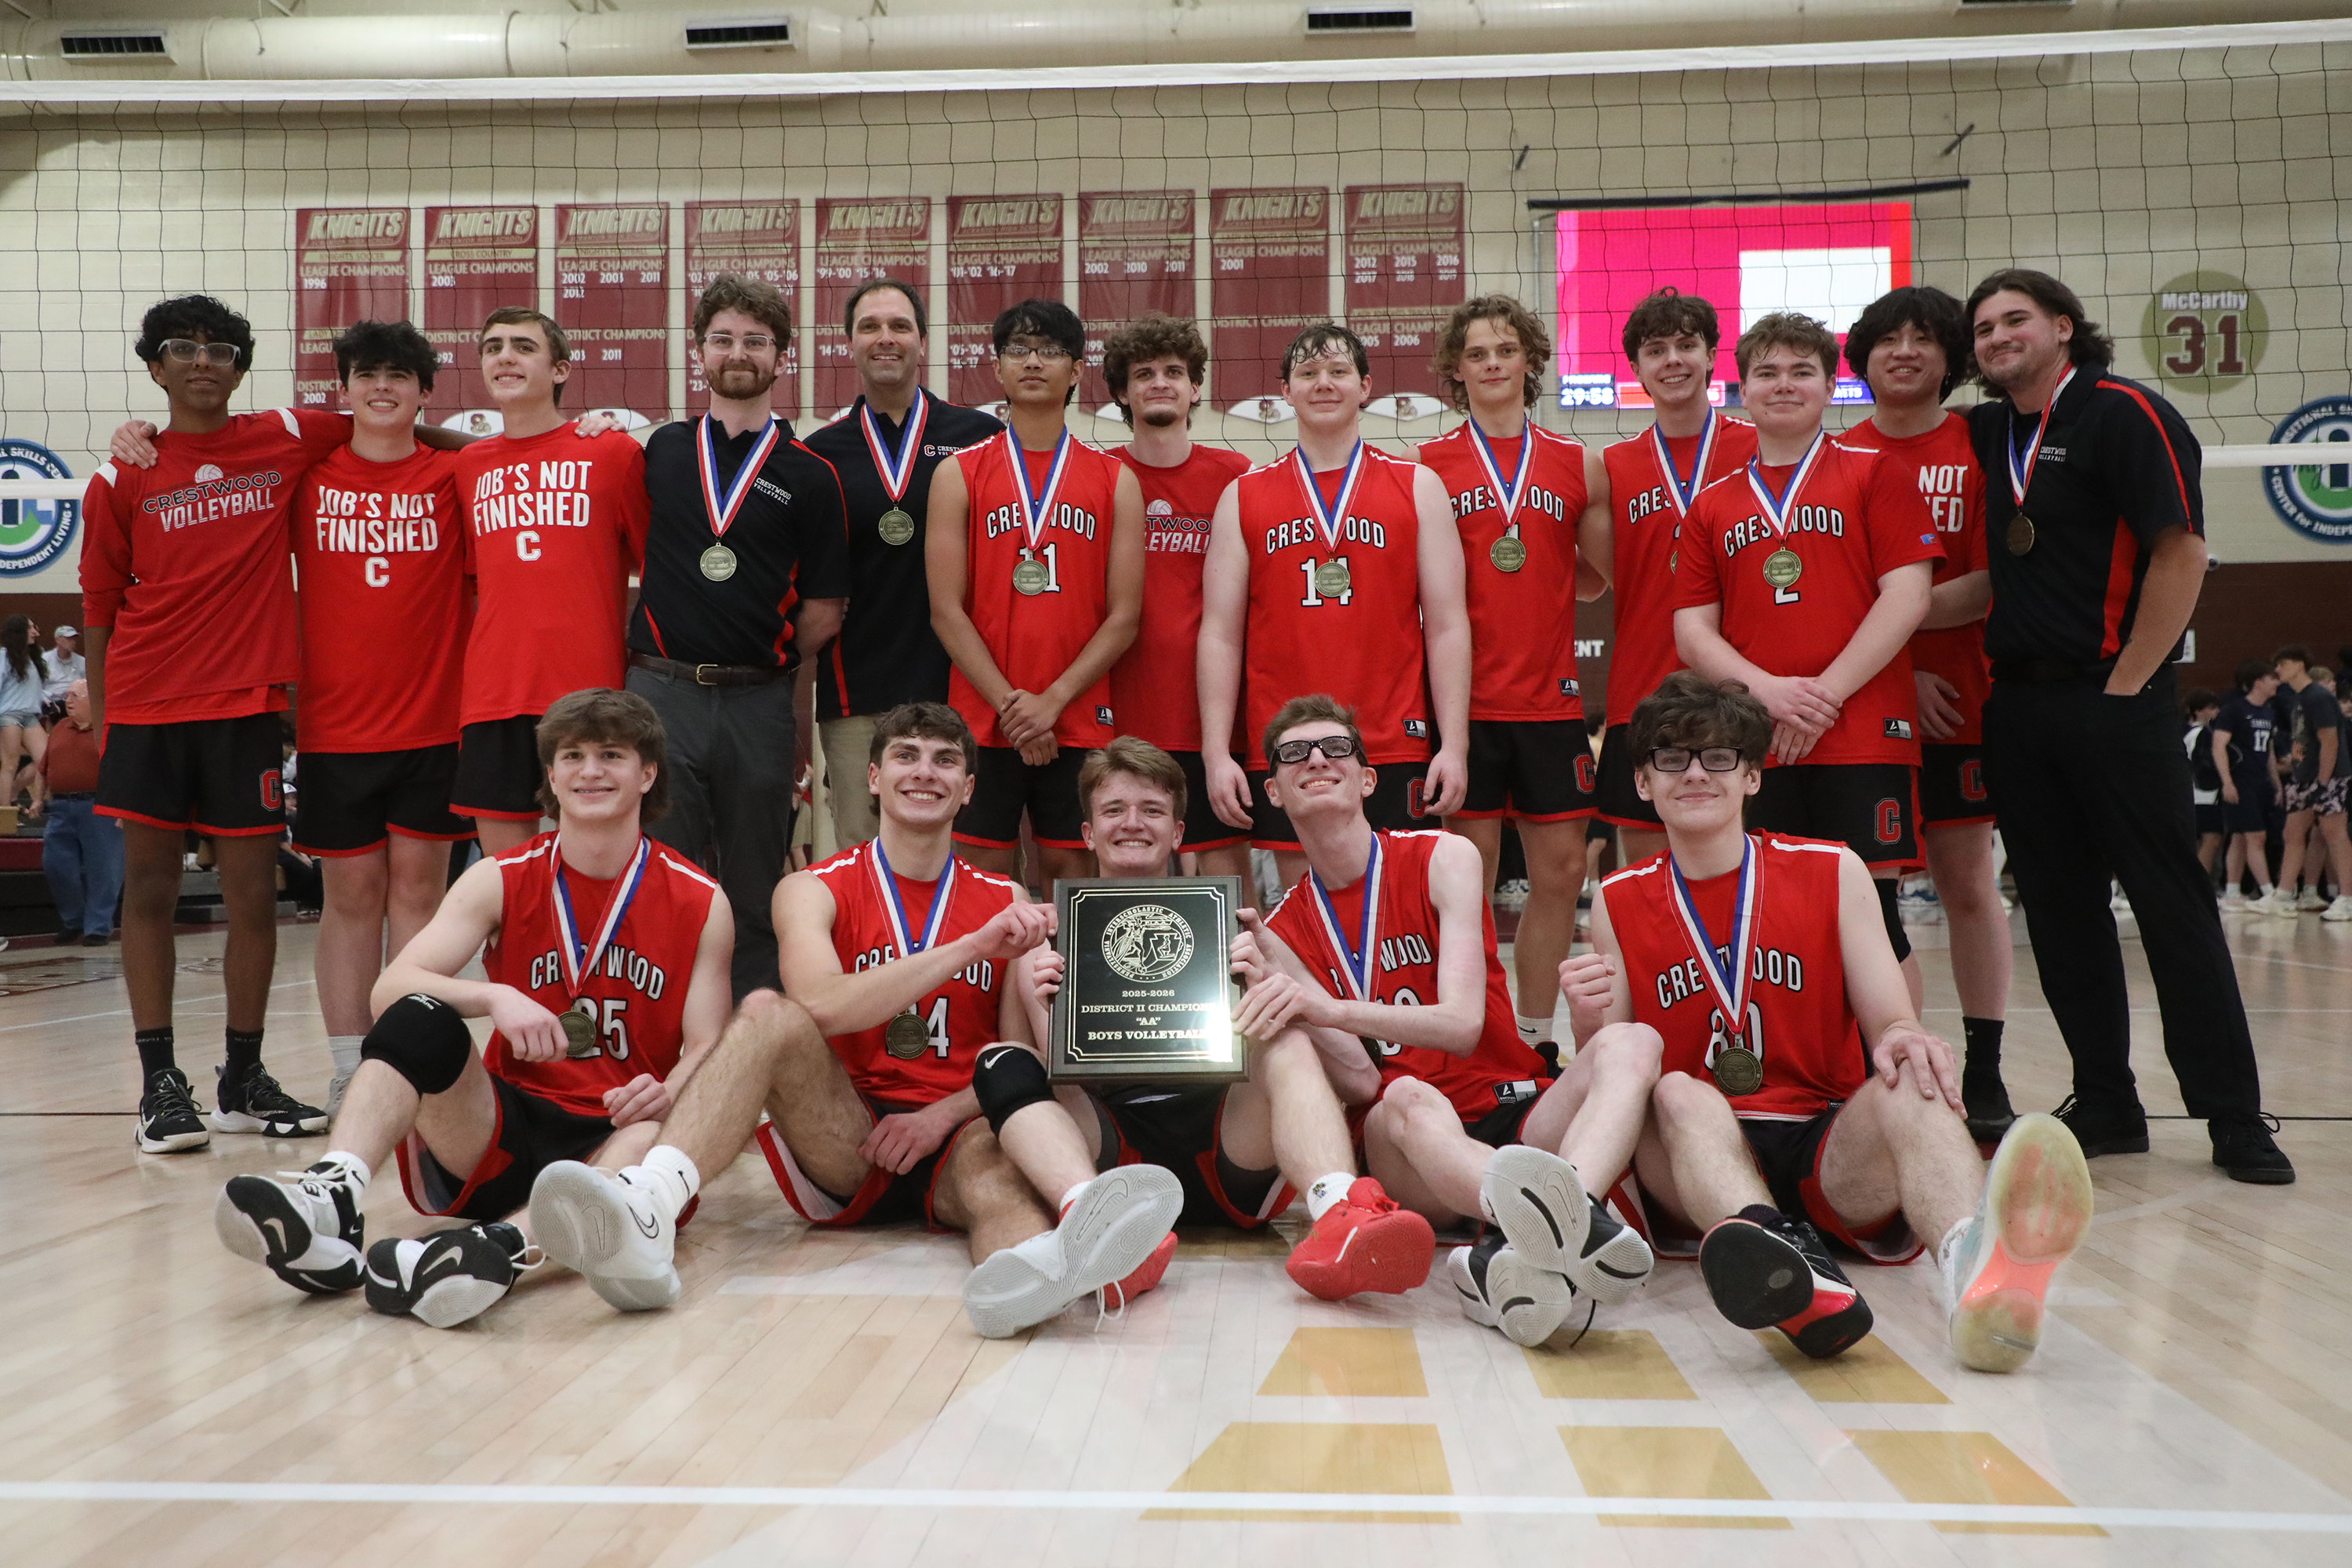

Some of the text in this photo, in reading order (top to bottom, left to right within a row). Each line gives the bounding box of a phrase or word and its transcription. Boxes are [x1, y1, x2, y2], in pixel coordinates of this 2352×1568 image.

[961, 200, 1057, 227] KNIGHTS
[1093, 196, 1188, 224] KNIGHTS
[1225, 193, 1320, 221] KNIGHTS
[1359, 189, 1455, 218] KNIGHTS
[310, 212, 403, 239] KNIGHTS
[439, 210, 533, 238] KNIGHTS
[569, 208, 660, 235] KNIGHTS
[700, 205, 791, 233] KNIGHTS
[830, 203, 924, 230] KNIGHTS
[820, 254, 927, 267] LEAGUE CHAMPIONS
[951, 252, 1058, 266] LEAGUE CHAMPIONS
[1085, 248, 1191, 262] LEAGUE CHAMPIONS
[1215, 245, 1325, 259] LEAGUE CHAMPIONS
[1349, 241, 1460, 257] LEAGUE CHAMPIONS
[300, 263, 405, 278] LEAGUE CHAMPIONS
[429, 262, 535, 274] LEAGUE CHAMPIONS
[559, 259, 665, 271] LEAGUE CHAMPIONS
[689, 258, 797, 270] LEAGUE CHAMPIONS
[1085, 263, 1109, 274] 2002
[1221, 259, 1244, 270] 2001
[1355, 254, 1460, 269] 2012 2015 2016
[303, 278, 328, 289] 1996
[562, 273, 586, 285] 2002
[641, 271, 661, 283] 2011
[1355, 270, 1377, 284] 2017
[2161, 291, 2249, 311] McCarthy
[425, 332, 472, 343] DISTRICT
[564, 328, 666, 341] ISTRICT CHAMPIONS
[1086, 339, 1105, 352] 199
[1394, 334, 1421, 347] 2006
[2165, 313, 2245, 377] 31
[300, 342, 333, 354] LEAGU
[602, 348, 622, 361] 2011
[298, 380, 343, 392] DISTRICT
[303, 393, 327, 405] 2002
[10, 447, 48, 466] SKILLS
[924, 444, 936, 457] C
[2040, 445, 2067, 456] CRESTWOOD
[473, 460, 593, 504] JOB'S NOT
[756, 477, 792, 500] CRESTWOOD
[1918, 464, 1969, 495] NOT
[142, 471, 282, 514] CRESTWOOD
[316, 485, 437, 519] JOB'S NOT
[753, 482, 789, 506] VOLLEYBALL
[1450, 481, 1565, 523] CRESOOD
[159, 488, 275, 532] VOLLEYBALL
[473, 491, 591, 538] FINISHED
[985, 499, 1097, 543] CREOOD
[51, 510, 73, 548] LIVING
[316, 517, 439, 554] FINISHED
[1266, 515, 1386, 555] CRESOOD
[1724, 504, 1845, 559] CRESOOD
[516, 530, 542, 561] C
[365, 557, 390, 588] C
[2253, 728, 2270, 753] 17
[1572, 752, 1595, 795] C
[260, 768, 282, 812] C
[1874, 797, 1902, 846] C
[1105, 906, 1165, 936] INTERSCHOLASTIC
[1168, 912, 1192, 939] ATHLETIC
[530, 942, 666, 1001] CRWOOD
[1656, 943, 1803, 1011] CREOOD
[1122, 989, 1175, 998] 2025-2026
[1081, 1004, 1134, 1014] DISTRICT
[1136, 1004, 1145, 1012] II
[572, 994, 630, 1062] 25
[1087, 1030, 1123, 1041] BOYS
